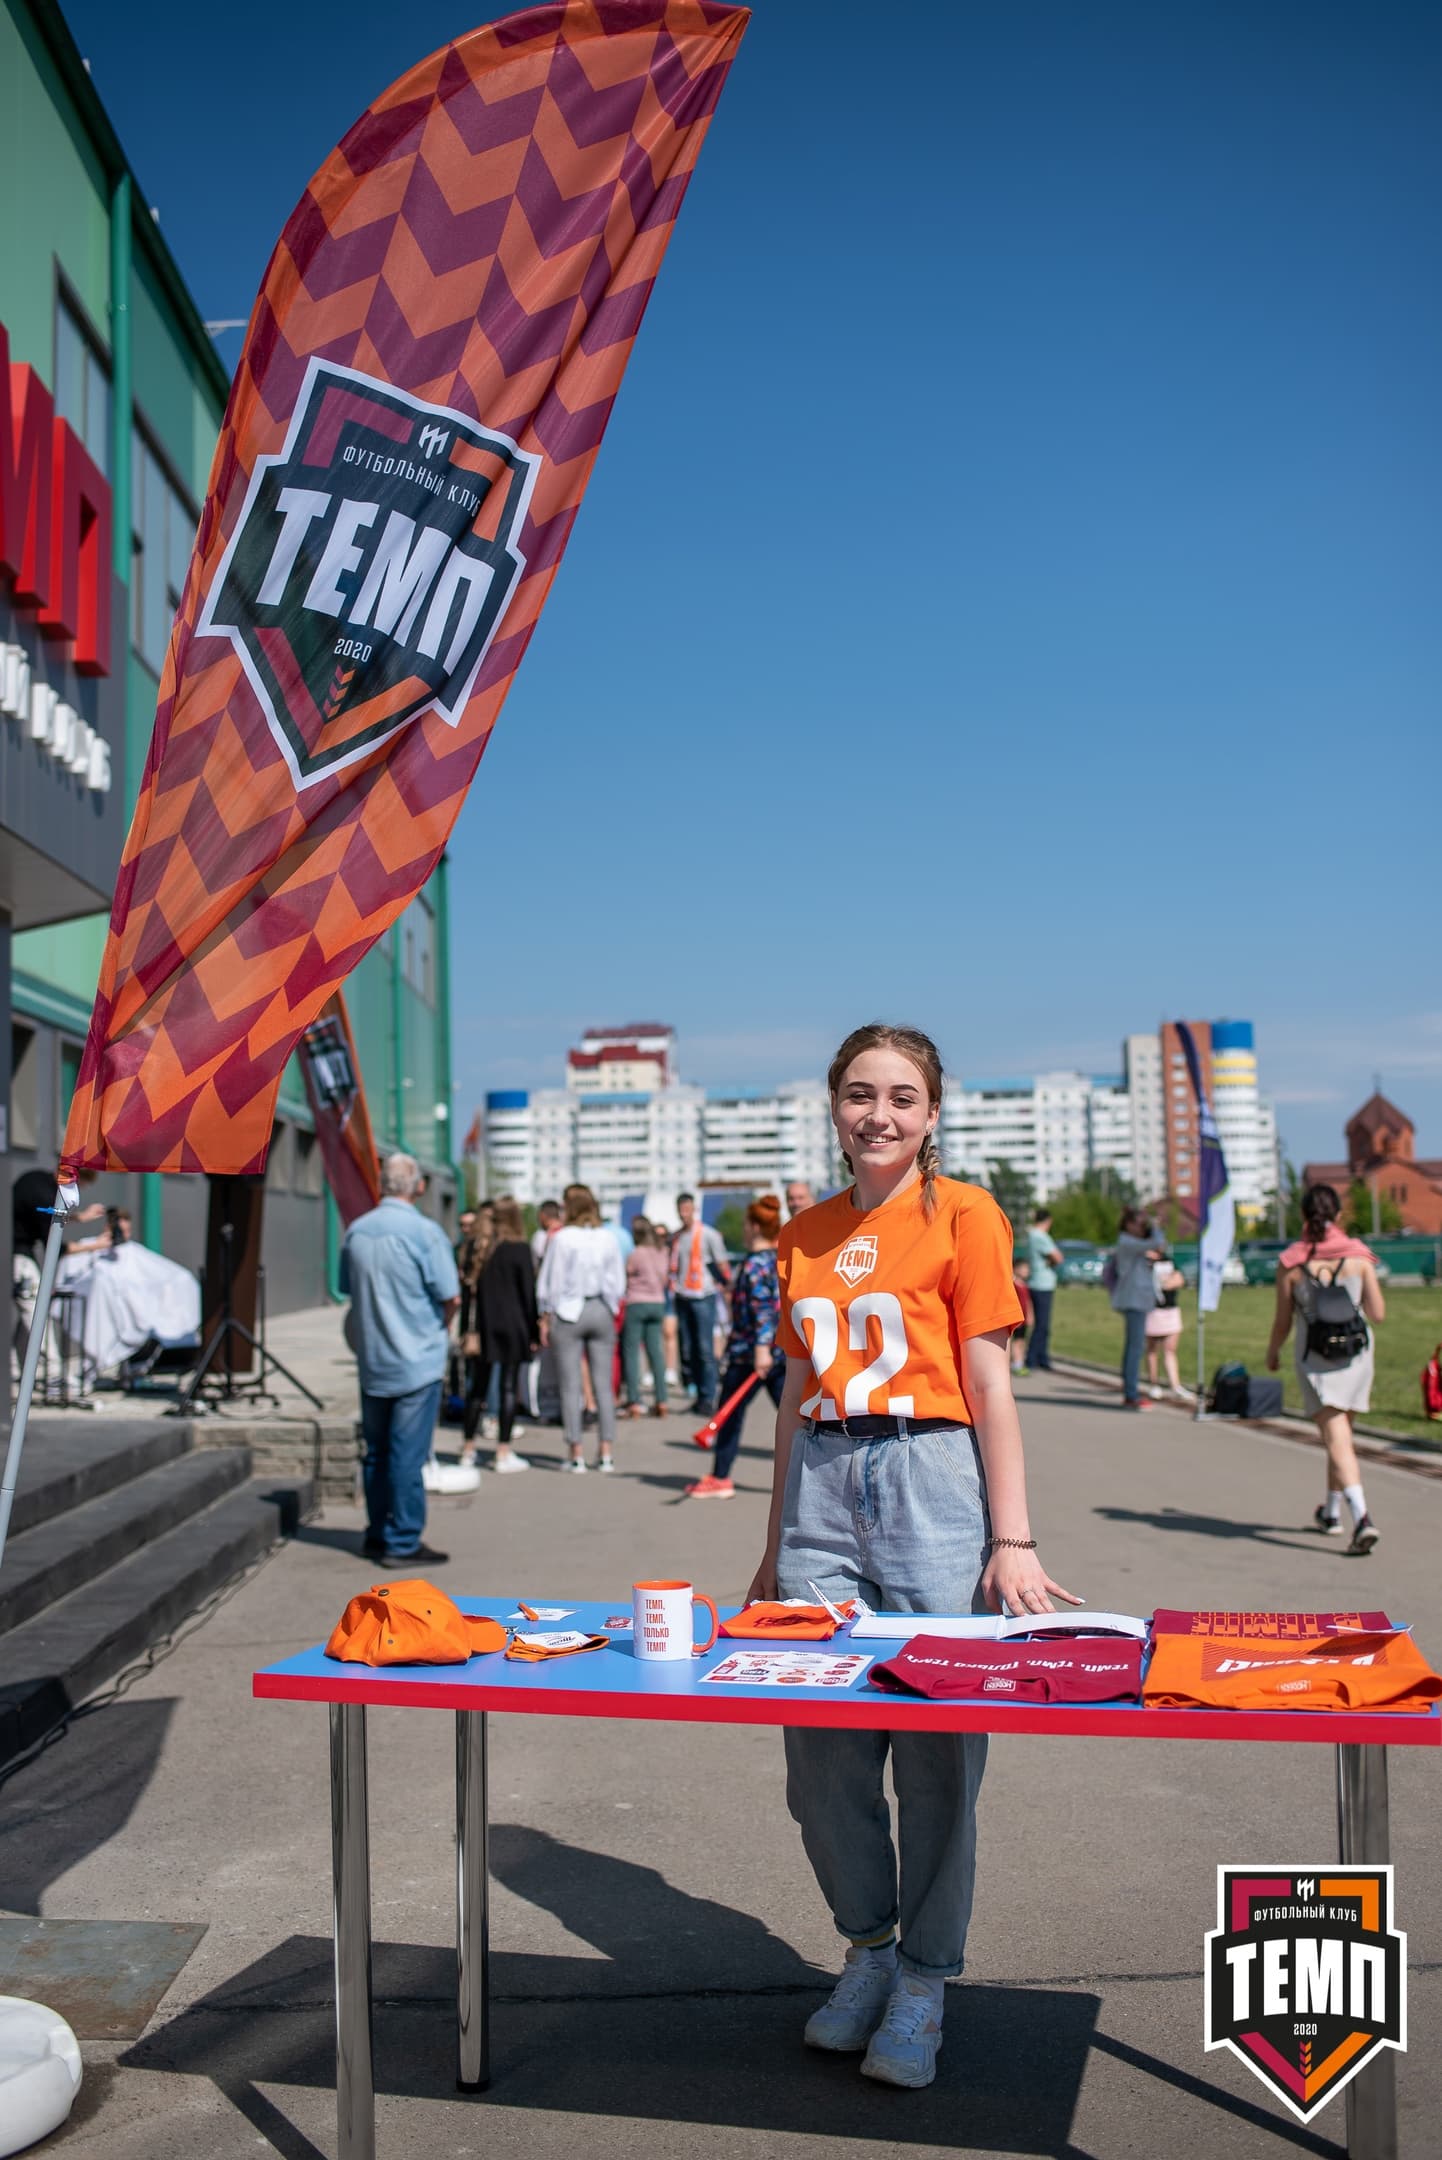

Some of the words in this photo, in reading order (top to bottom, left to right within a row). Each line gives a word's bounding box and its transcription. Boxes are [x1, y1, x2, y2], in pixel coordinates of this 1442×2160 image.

[343, 446, 446, 496] ФУТБОЛЬНЫЙ
[255, 487, 496, 676] ТЕМП
[334, 638, 372, 662] 2020
[840, 1250, 875, 1269] ТЕМП
[791, 1292, 915, 1420] 22
[643, 1627, 669, 1638] ТОЛЬКО
[646, 1641, 666, 1652] ТЕМП!
